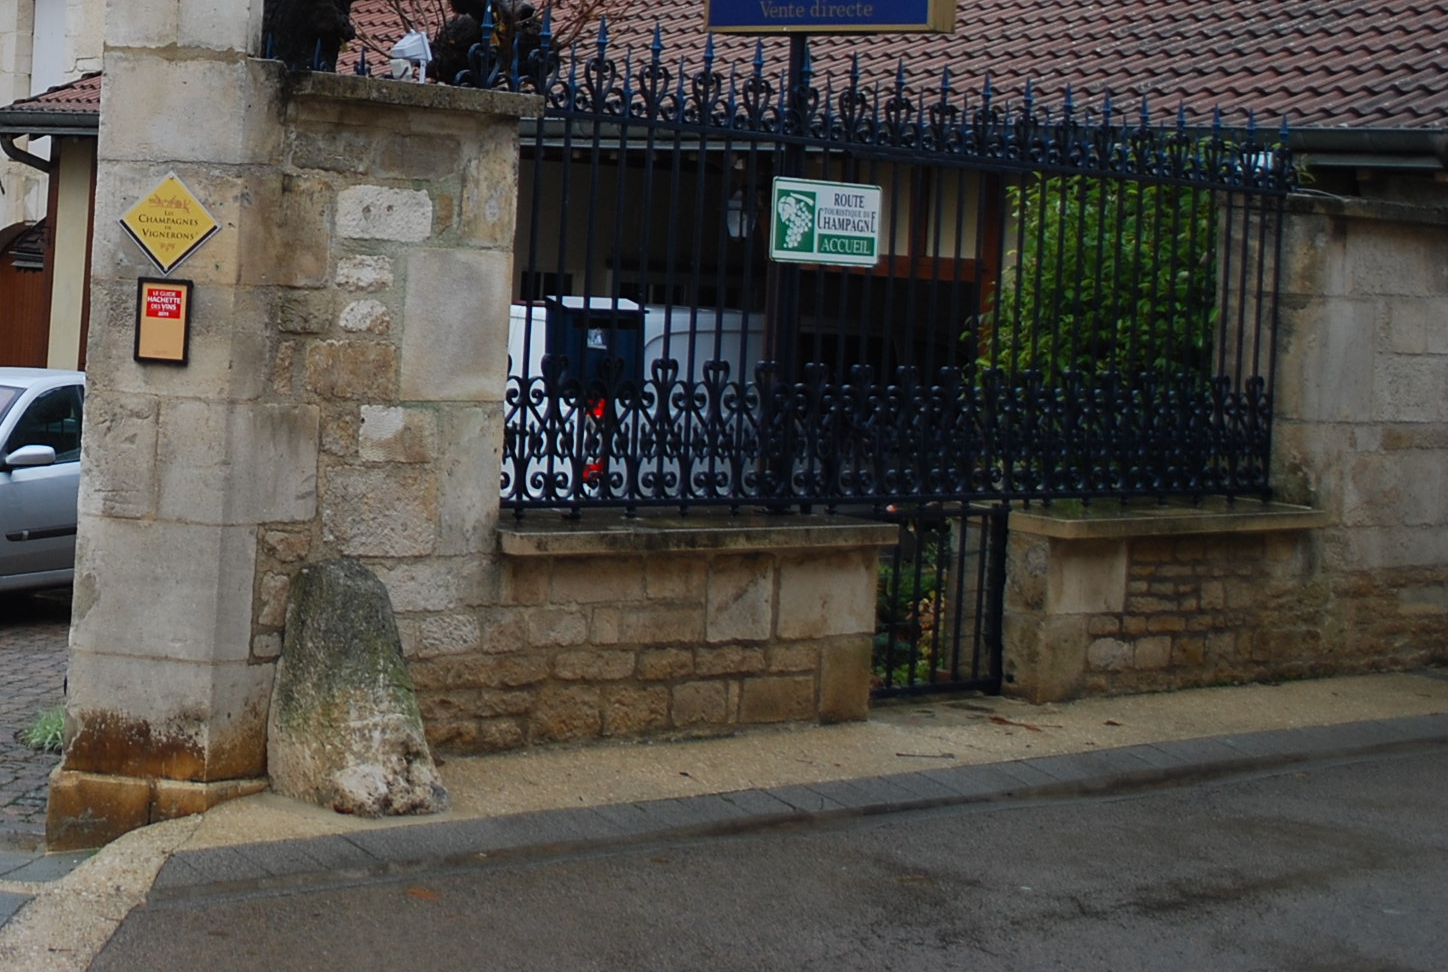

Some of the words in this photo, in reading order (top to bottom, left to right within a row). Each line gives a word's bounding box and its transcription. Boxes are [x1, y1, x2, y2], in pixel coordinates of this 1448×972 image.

[760, 1, 805, 18] Vente
[810, 0, 873, 18] directe
[834, 193, 864, 208] ROUTE
[818, 208, 876, 233] CHAMPAGNE
[824, 208, 862, 218] TOURISTIQUE
[821, 238, 870, 254] ACCUEIL
[147, 296, 181, 304] HACHETTE
[161, 303, 177, 311] VINS
